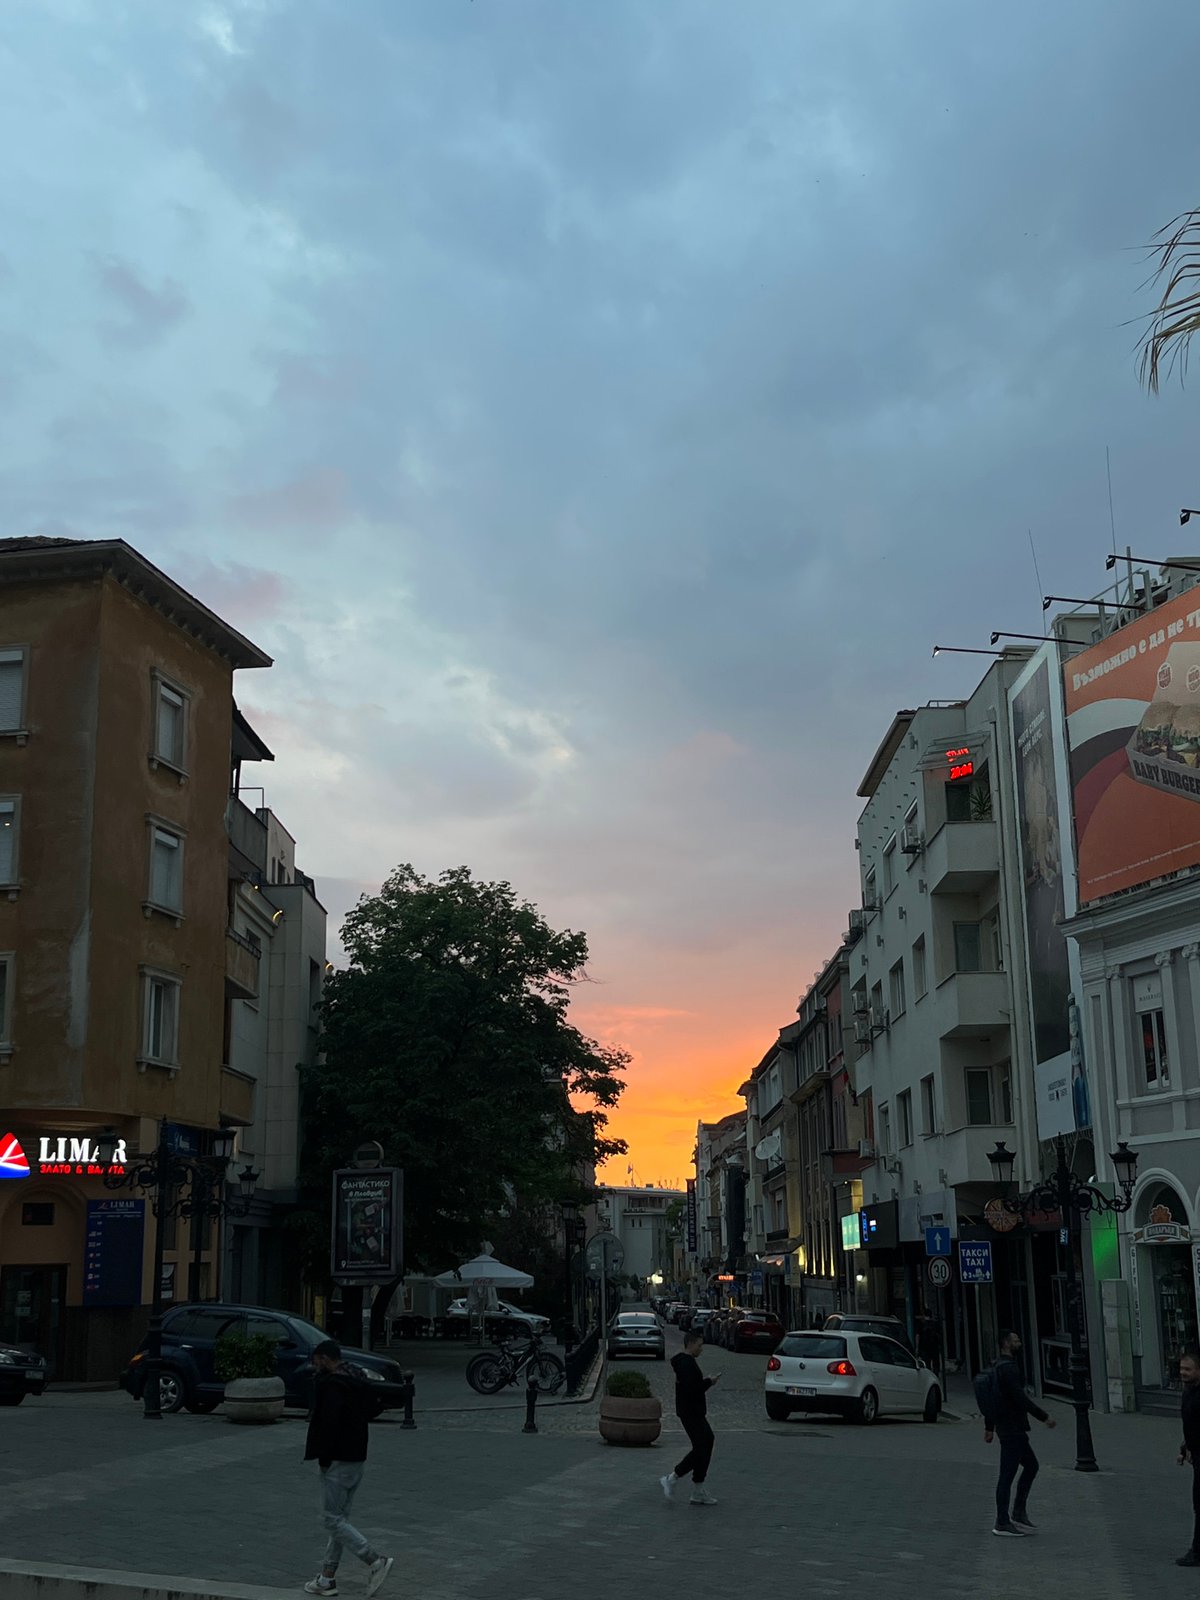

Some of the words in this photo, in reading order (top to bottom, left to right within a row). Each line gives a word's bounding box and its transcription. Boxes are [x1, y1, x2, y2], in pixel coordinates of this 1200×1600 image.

[1073, 645, 1137, 691] Възможно
[1139, 640, 1146, 654] е
[1149, 629, 1165, 650] да
[1167, 619, 1184, 638] не
[1133, 759, 1160, 783] BABY
[40, 1164, 71, 1174] ЗЛАТО
[961, 1248, 989, 1257] ТАКСИ
[966, 1258, 985, 1267] TAXI
[933, 1264, 947, 1279] 30
